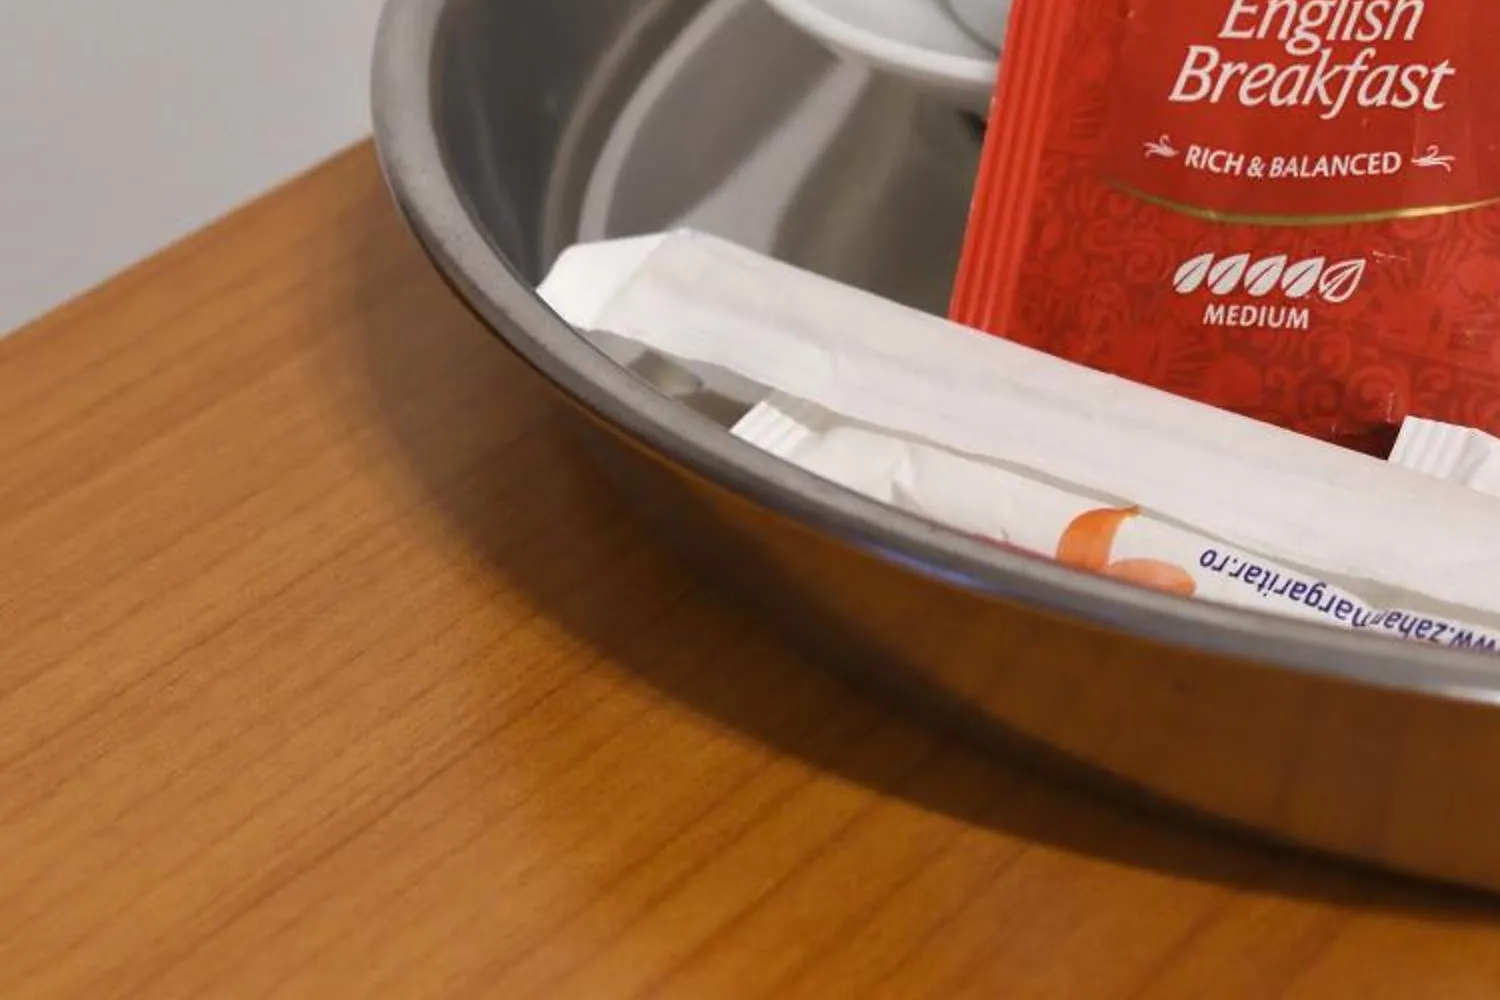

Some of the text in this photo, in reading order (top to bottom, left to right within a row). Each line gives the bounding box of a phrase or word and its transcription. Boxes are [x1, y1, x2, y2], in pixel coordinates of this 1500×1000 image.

[1168, 45, 1456, 120] Breakfast
[1184, 145, 1402, 179] RICH & BALANCED
[1202, 303, 1310, 331] MEDIUM
